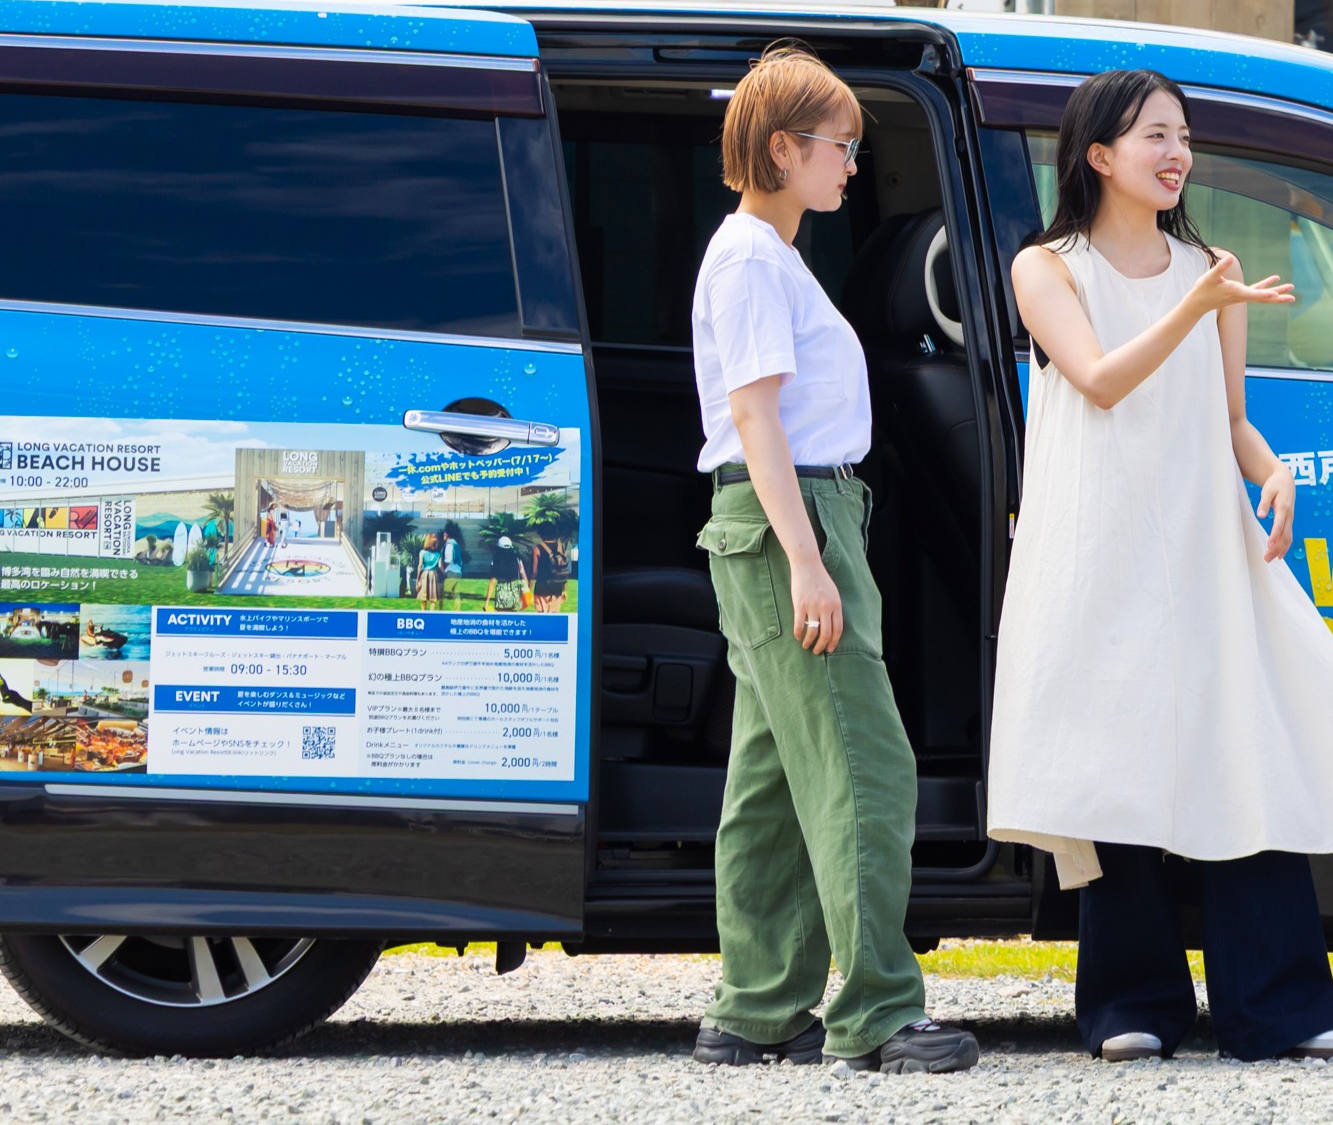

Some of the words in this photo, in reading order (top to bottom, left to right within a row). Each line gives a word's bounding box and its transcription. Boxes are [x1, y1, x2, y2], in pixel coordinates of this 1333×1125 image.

[17, 442, 50, 452] LONG
[53, 442, 114, 453] VACATION
[117, 444, 161, 454] RESORT
[283, 450, 318, 462] LONG
[17, 454, 85, 471] BEACH
[91, 456, 161, 473] HOUSE
[10, 475, 43, 487] 10:00
[55, 476, 89, 488] 22:00
[103, 500, 112, 540] RESORT
[123, 500, 132, 530] LONG
[7, 529, 53, 538] VACATION
[56, 530, 98, 539] RESORT
[113, 500, 122, 556] VACATION
[167, 613, 232, 626] ACTIVITY
[396, 618, 425, 630] BBQ
[504, 648, 533, 660] 5,000
[230, 663, 263, 675] 09:00
[276, 664, 307, 676] 15:30
[498, 672, 533, 684] 10,000
[175, 690, 220, 702] EVENT
[485, 702, 520, 715] 10,000
[502, 727, 532, 738] 2,000
[501, 756, 531, 768] 2,000
